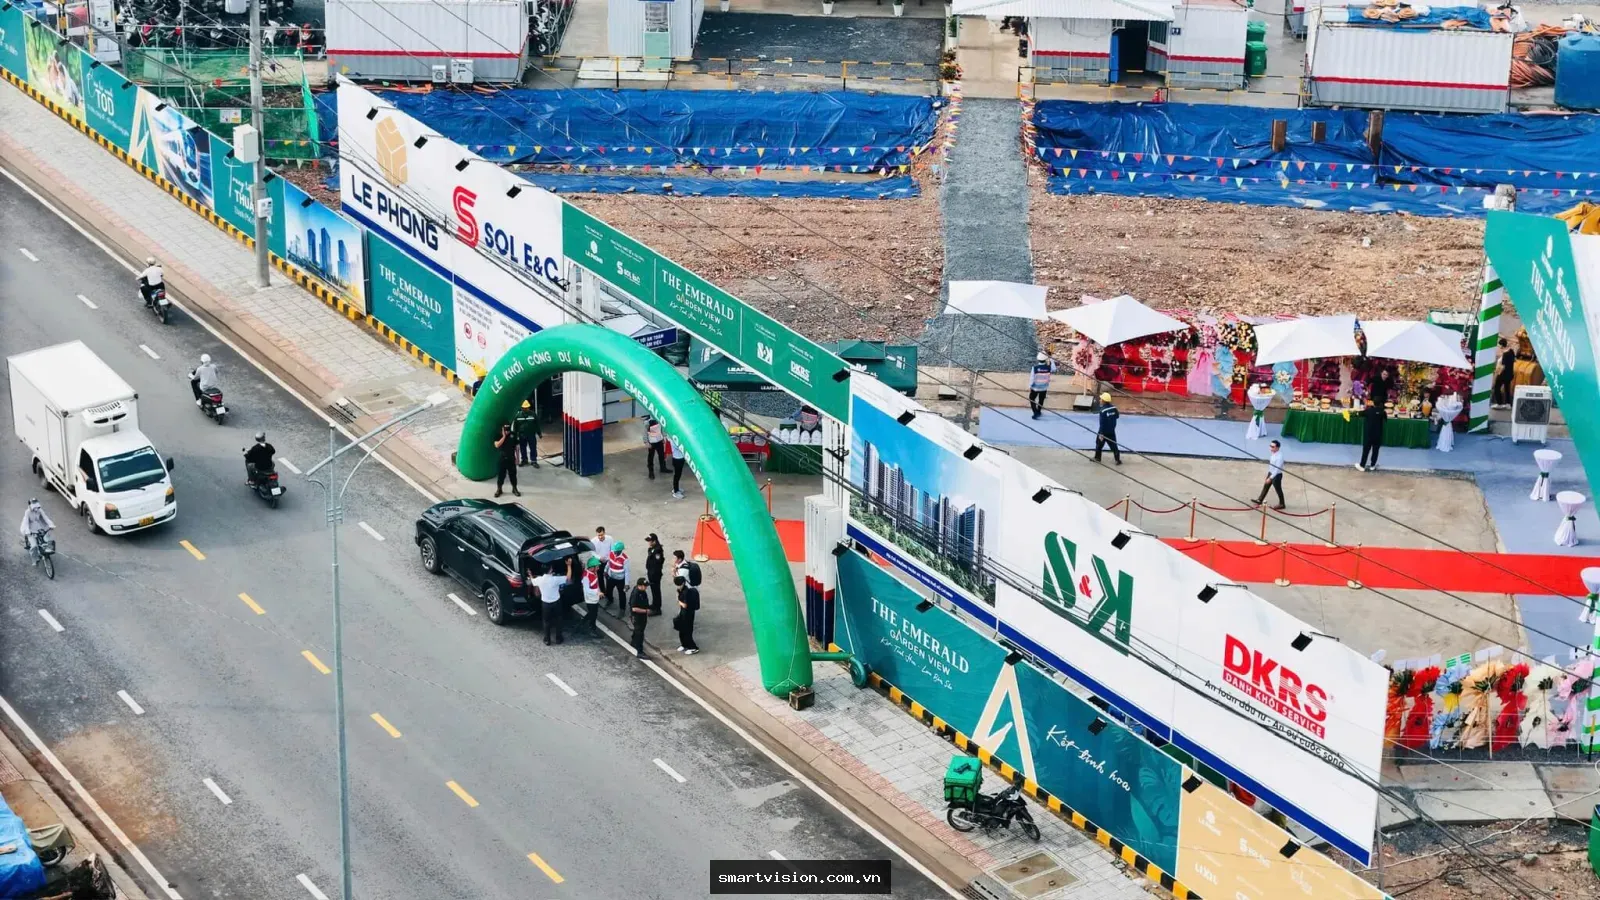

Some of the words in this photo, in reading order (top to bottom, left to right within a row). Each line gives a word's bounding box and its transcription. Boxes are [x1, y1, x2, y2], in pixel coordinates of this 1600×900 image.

[95, 88, 114, 116] TOD
[351, 174, 373, 211] LE
[377, 190, 439, 251] PHONG
[484, 221, 519, 264] SOL
[523, 242, 559, 284] E&C
[379, 263, 398, 286] THE
[399, 276, 442, 315] EMERALD
[415, 303, 431, 318] VIEW
[661, 269, 682, 292] THE
[685, 282, 735, 321] EMERALD
[675, 293, 703, 315] GARDEN
[703, 309, 721, 325] VIEW
[1531, 260, 1545, 303] THE
[1543, 288, 1576, 372] EMERALD
[503, 357, 525, 382] KHỞI
[527, 350, 552, 367] CÔNG
[557, 351, 572, 365] DỰ
[578, 351, 592, 369] ÁN
[598, 362, 617, 382] THE
[624, 378, 667, 429] EMERALD
[871, 597, 898, 627] THE
[902, 618, 970, 674] EMERALD
[890, 629, 926, 660] GARDEN
[927, 654, 951, 677] VIEW
[1223, 633, 1328, 723] DKRS
[1225, 672, 1253, 696] DANH
[1281, 706, 1322, 737] SERVICE
[1108, 769, 1131, 792] hoa
